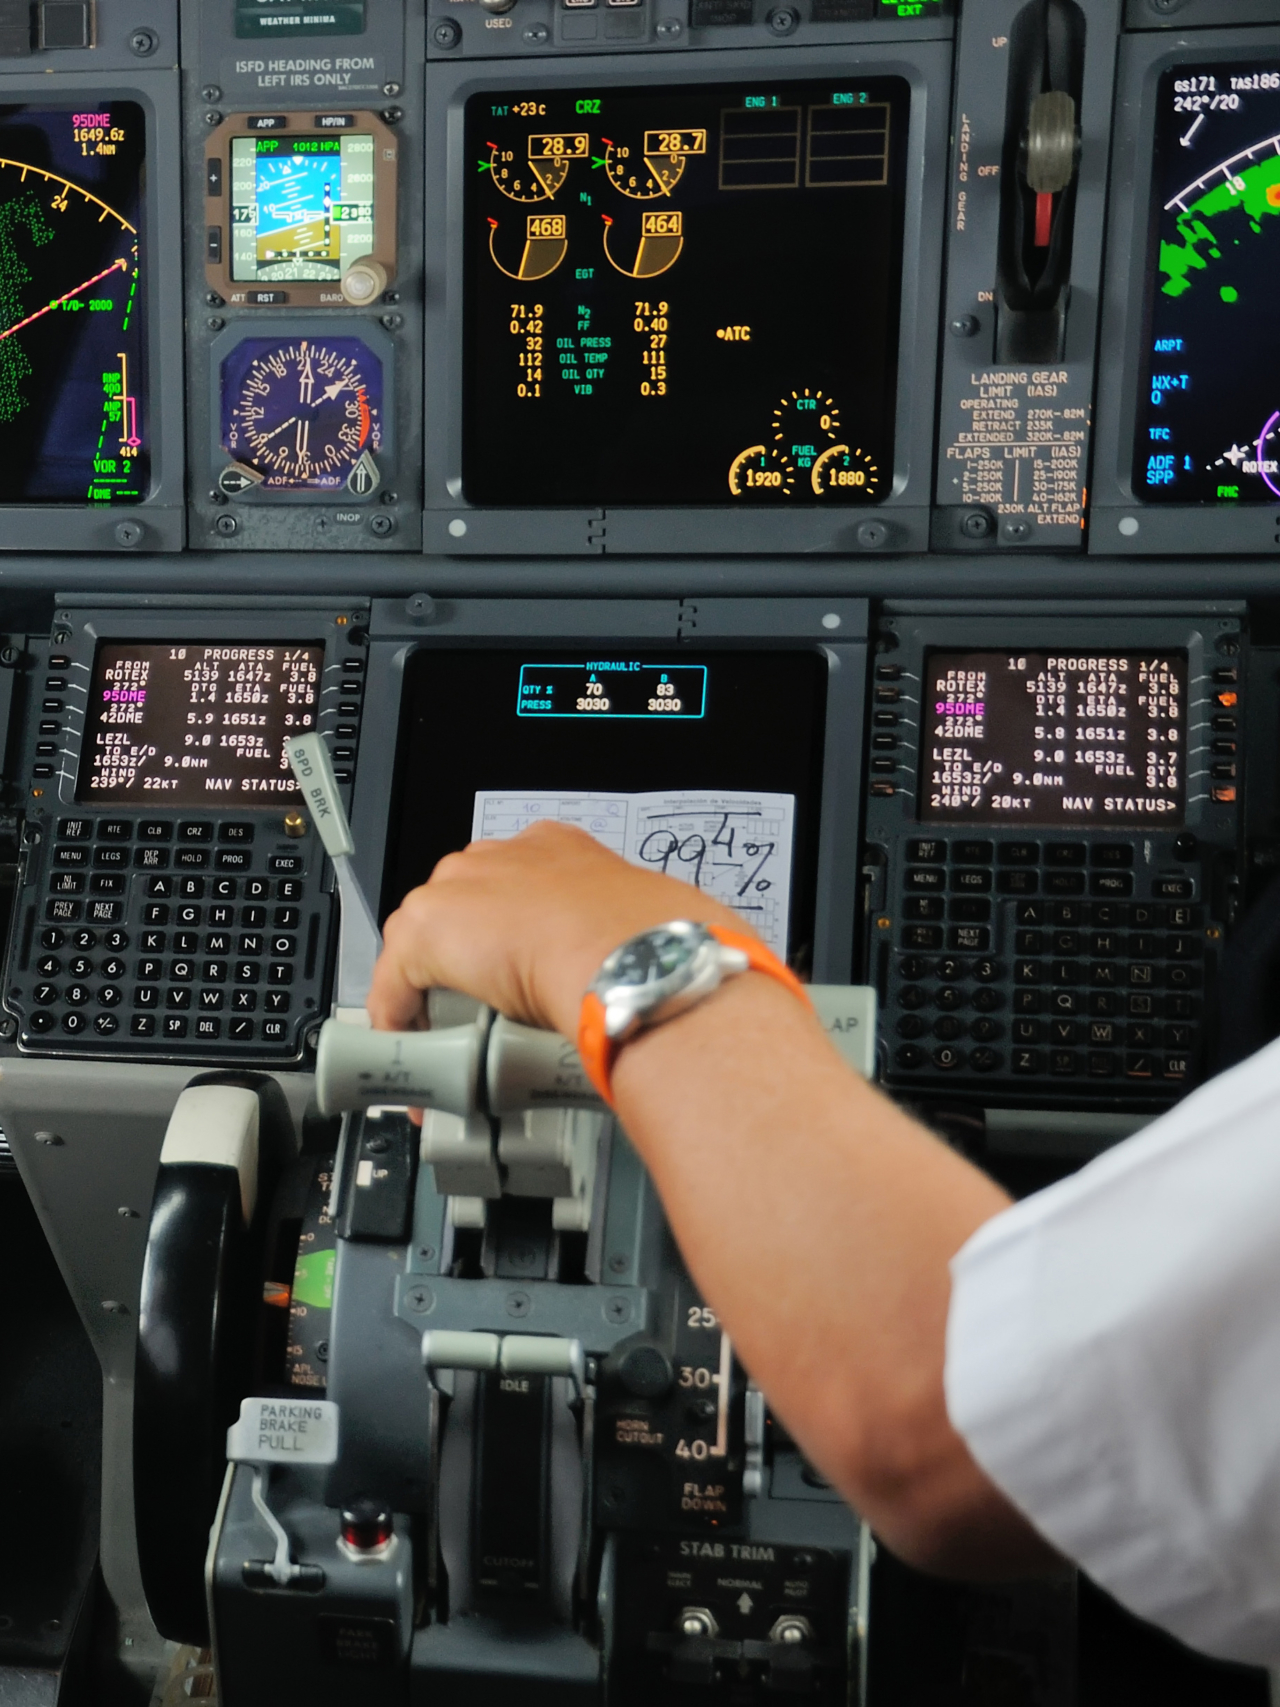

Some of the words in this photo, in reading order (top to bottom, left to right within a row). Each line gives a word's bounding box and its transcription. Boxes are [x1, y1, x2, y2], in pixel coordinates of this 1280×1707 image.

[898, 4, 922, 16] EXT
[260, 17, 300, 25] WEATHER
[486, 19, 511, 28] USED
[992, 37, 1007, 47] UP
[236, 61, 264, 72] ISFD
[268, 59, 330, 72] HEADING
[334, 57, 375, 69] FROM
[258, 75, 286, 86] LEFT
[291, 74, 309, 85] IRS
[314, 73, 350, 85] ONLY
[492, 106, 508, 115] TAT
[576, 100, 600, 113] CRZ
[72, 113, 111, 128] 95DME
[257, 119, 274, 127] APP
[322, 118, 345, 127] HP/IN
[257, 141, 278, 152] APP
[291, 140, 318, 151] 1012
[320, 142, 340, 151] HPA
[541, 138, 585, 155] 28.9
[658, 133, 702, 151] 28.7
[978, 166, 999, 176] OFF
[530, 219, 562, 235] 468
[646, 216, 678, 233] 464
[576, 268, 594, 279] EGT
[258, 294, 273, 302] RST
[978, 291, 994, 302] DN
[511, 304, 543, 318] 71.9
[510, 320, 542, 334] 0.42
[724, 326, 751, 341] ATC
[527, 337, 542, 350] 32
[557, 338, 574, 348] OIL
[580, 337, 612, 347] PRESS
[1154, 338, 1183, 352] ARPT
[520, 353, 542, 366] 112
[970, 371, 1029, 386] LANDING
[1032, 371, 1067, 383] GEAR
[980, 386, 1013, 397] LIMIT
[1028, 385, 1057, 396] (IAS)
[959, 398, 1020, 410] OPERATING
[973, 409, 1016, 420] EXTEND
[973, 420, 1022, 431] RETRACT
[1026, 420, 1054, 431] 235K
[957, 431, 1015, 442] EXTENDED
[791, 445, 817, 456] FUEL
[946, 446, 991, 459] FLAPS
[1005, 447, 1037, 458] LIMIT
[1051, 445, 1082, 458] (IAS)
[798, 457, 811, 467] KG
[1148, 456, 1174, 471] ADF
[268, 476, 287, 485] ADF
[745, 470, 782, 487] 1920
[829, 470, 865, 486] 1880
[997, 503, 1025, 515] 230K
[1028, 503, 1048, 513] ALT
[1051, 503, 1080, 512] FLAP
[336, 513, 361, 522] INOP
[1037, 513, 1081, 525] EXTEND
[204, 649, 274, 660] PROGRESS
[284, 650, 308, 660] 1/4
[116, 661, 150, 670] FROM
[585, 661, 641, 671] HYDRAULIC
[1047, 658, 1129, 671] PROGRESS
[105, 669, 149, 680] ROTEX
[584, 682, 603, 697] 70
[655, 682, 675, 697] 83
[103, 690, 147, 702] 95DME
[521, 699, 552, 710] PRESS
[575, 698, 610, 712] 3030
[647, 698, 682, 712] 3030
[99, 712, 143, 724] 42DME
[97, 733, 130, 744] LEZL
[933, 748, 972, 760] LEZL
[1147, 752, 1177, 764] 3.7
[101, 768, 136, 777] WIND
[1095, 765, 1134, 775] FUEL
[1147, 766, 1176, 777] QTY
[206, 779, 232, 790] NAV
[1063, 797, 1093, 809] NAV
[147, 826, 162, 835] CLB
[60, 851, 81, 861] MENU
[102, 852, 120, 860] LEGS
[222, 853, 243, 864] PROG
[276, 859, 294, 867] EXEC
[681, 1367, 710, 1387] 30
[259, 1402, 323, 1421] PARKING
[258, 1419, 309, 1434] BRAKE
[257, 1434, 305, 1453] PULL
[676, 1440, 707, 1459] 40
[678, 1540, 727, 1560] STAB
[730, 1544, 776, 1564] TRIM
